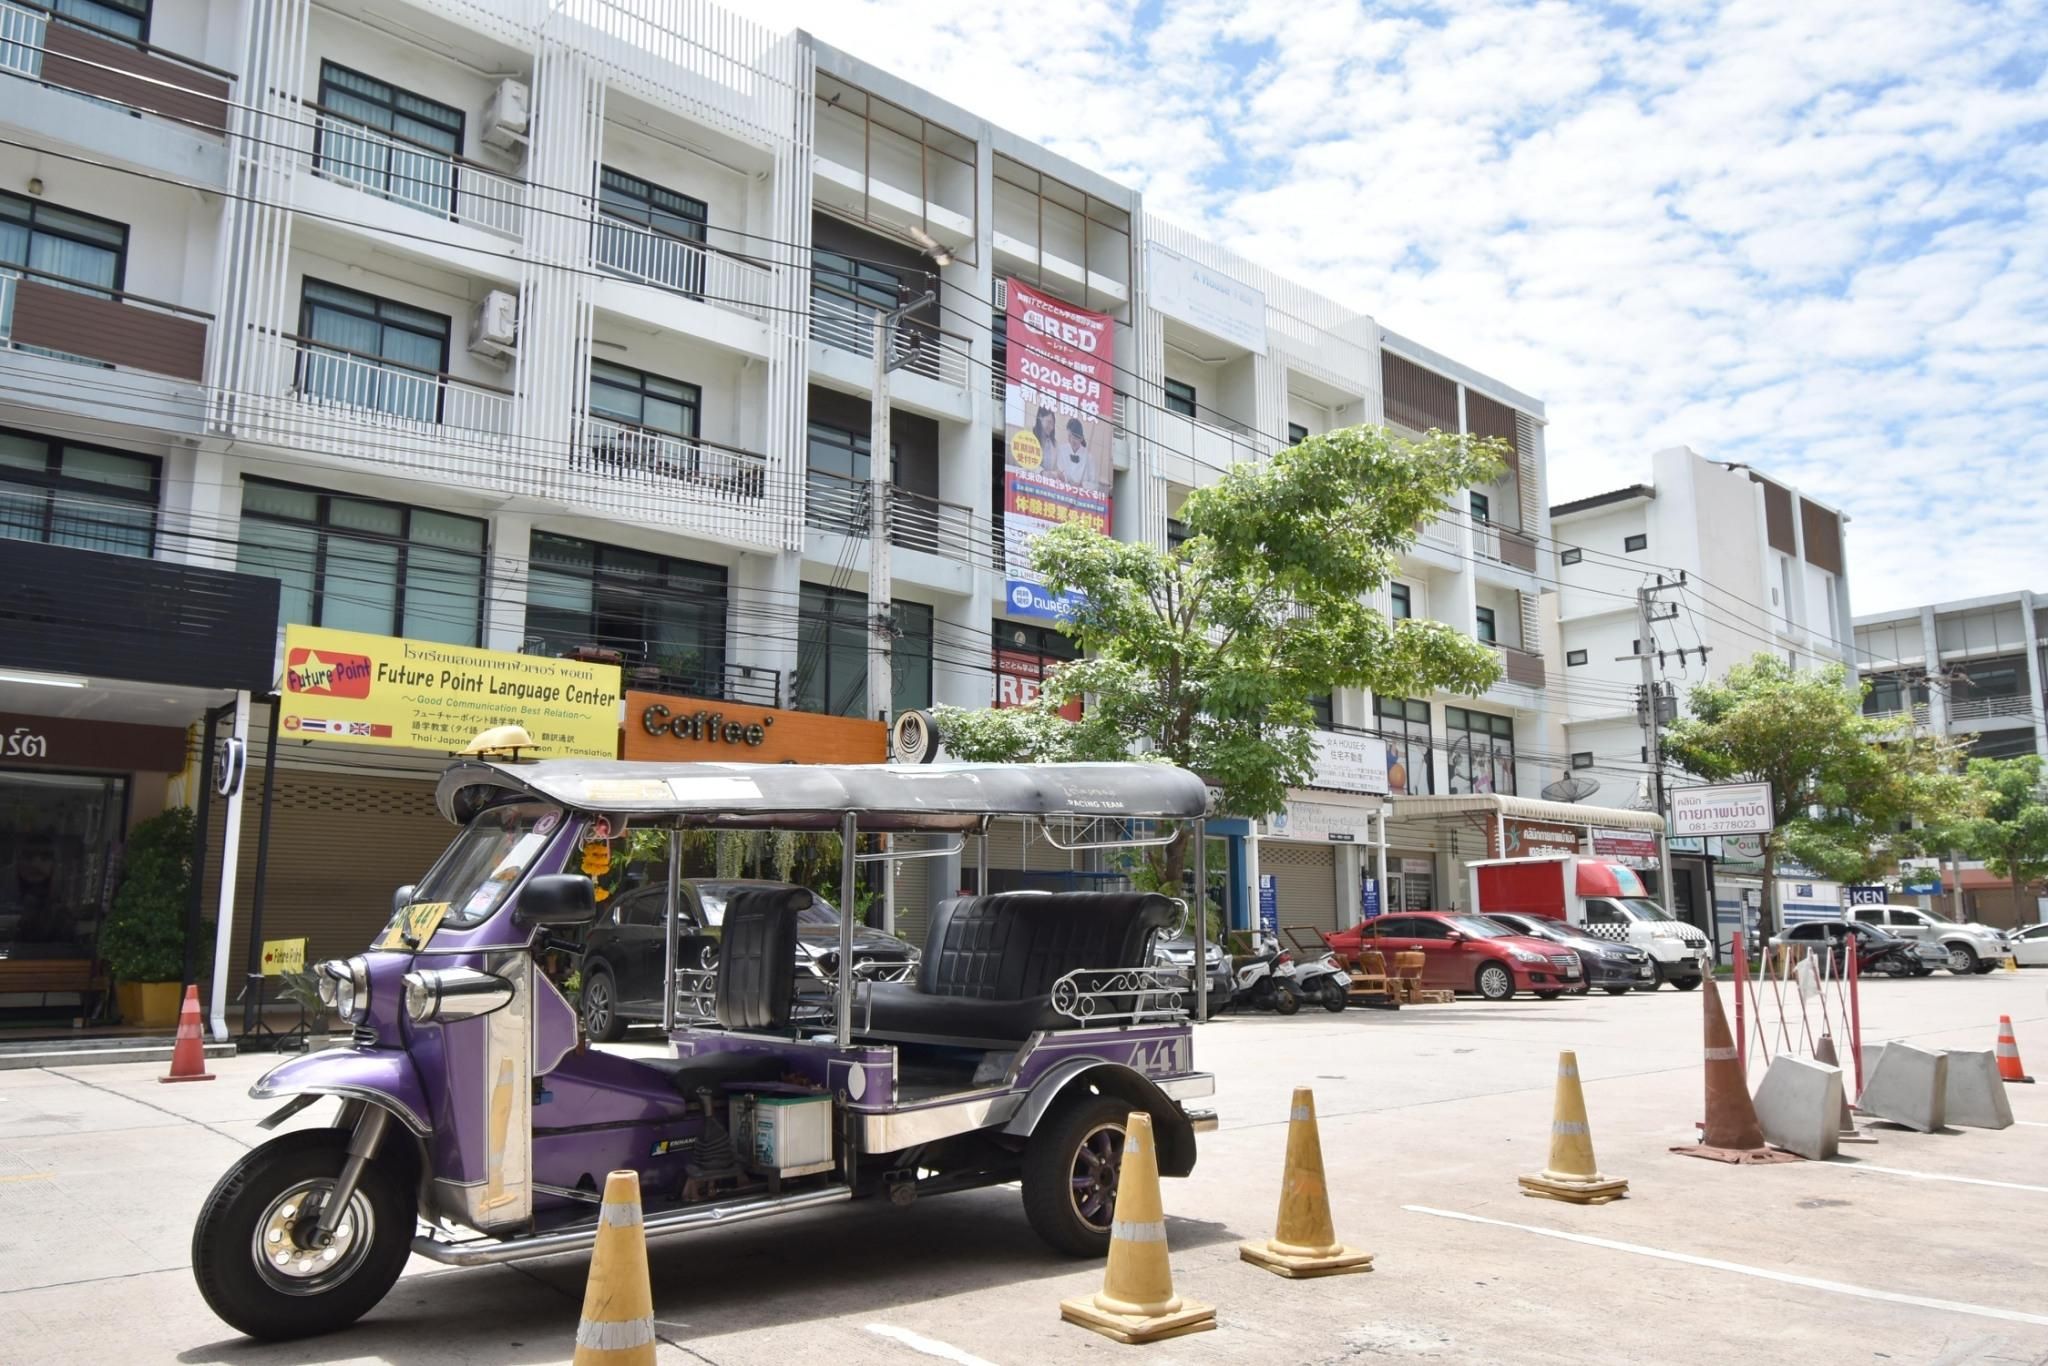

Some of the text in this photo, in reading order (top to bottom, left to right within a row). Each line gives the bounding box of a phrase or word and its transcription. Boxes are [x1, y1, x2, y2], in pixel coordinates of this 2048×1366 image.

[1044, 316, 1097, 353] RED
[1020, 357, 1100, 399] 2020年8月
[1020, 378, 1100, 424] 新規開校
[287, 658, 371, 689] Future Point
[377, 662, 616, 707] Future Point Language Center
[446, 698, 518, 713] Communication
[521, 705, 541, 715] Best
[643, 703, 765, 747] Coffee
[564, 746, 613, 758] Translation
[1067, 799, 1124, 809] RACING TEAM
[1677, 796, 1702, 807] คลินิก
[1688, 819, 1757, 832] 081-3778023
[1738, 841, 1760, 850] OLIV
[1853, 889, 1885, 905] KEN
[1127, 1038, 1186, 1074] 441
